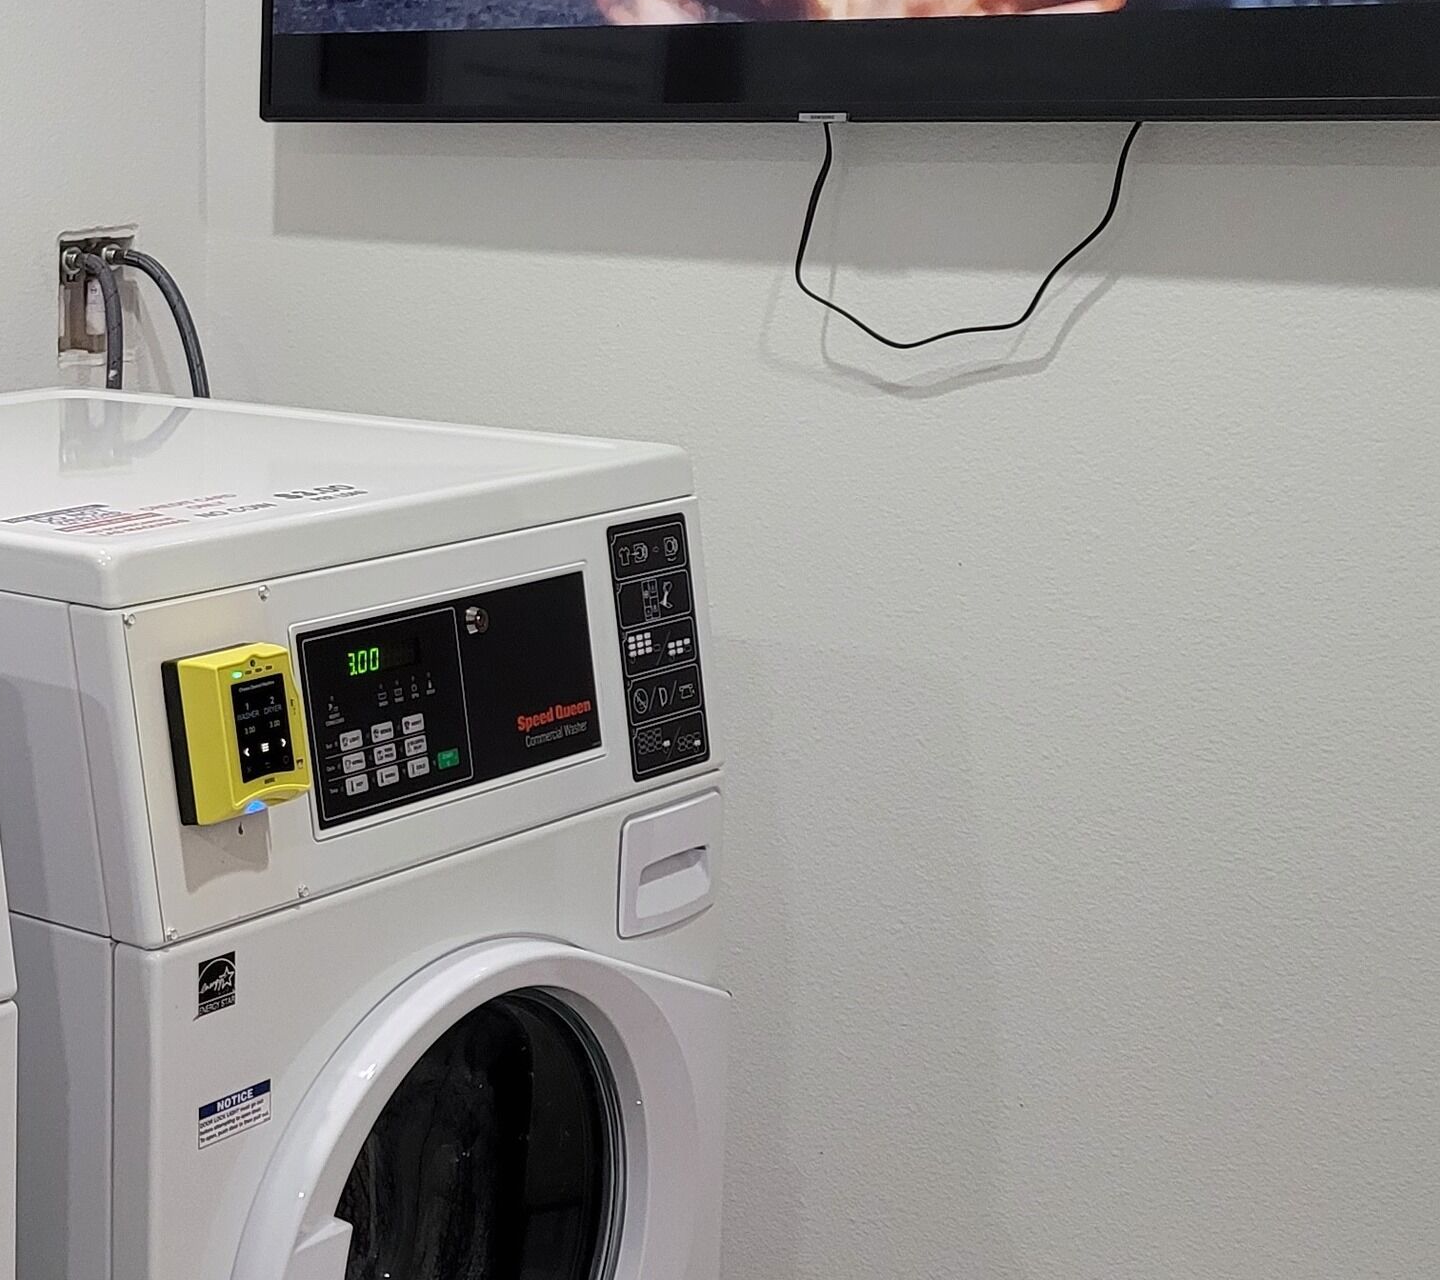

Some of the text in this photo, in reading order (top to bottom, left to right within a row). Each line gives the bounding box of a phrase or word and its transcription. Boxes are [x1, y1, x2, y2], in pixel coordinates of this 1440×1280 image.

[517, 700, 591, 733] Speed Queen
[525, 721, 587, 748] Commercial Washer
[199, 995, 235, 1015] ENERGY STAR
[217, 1088, 254, 1112] NOTICE
